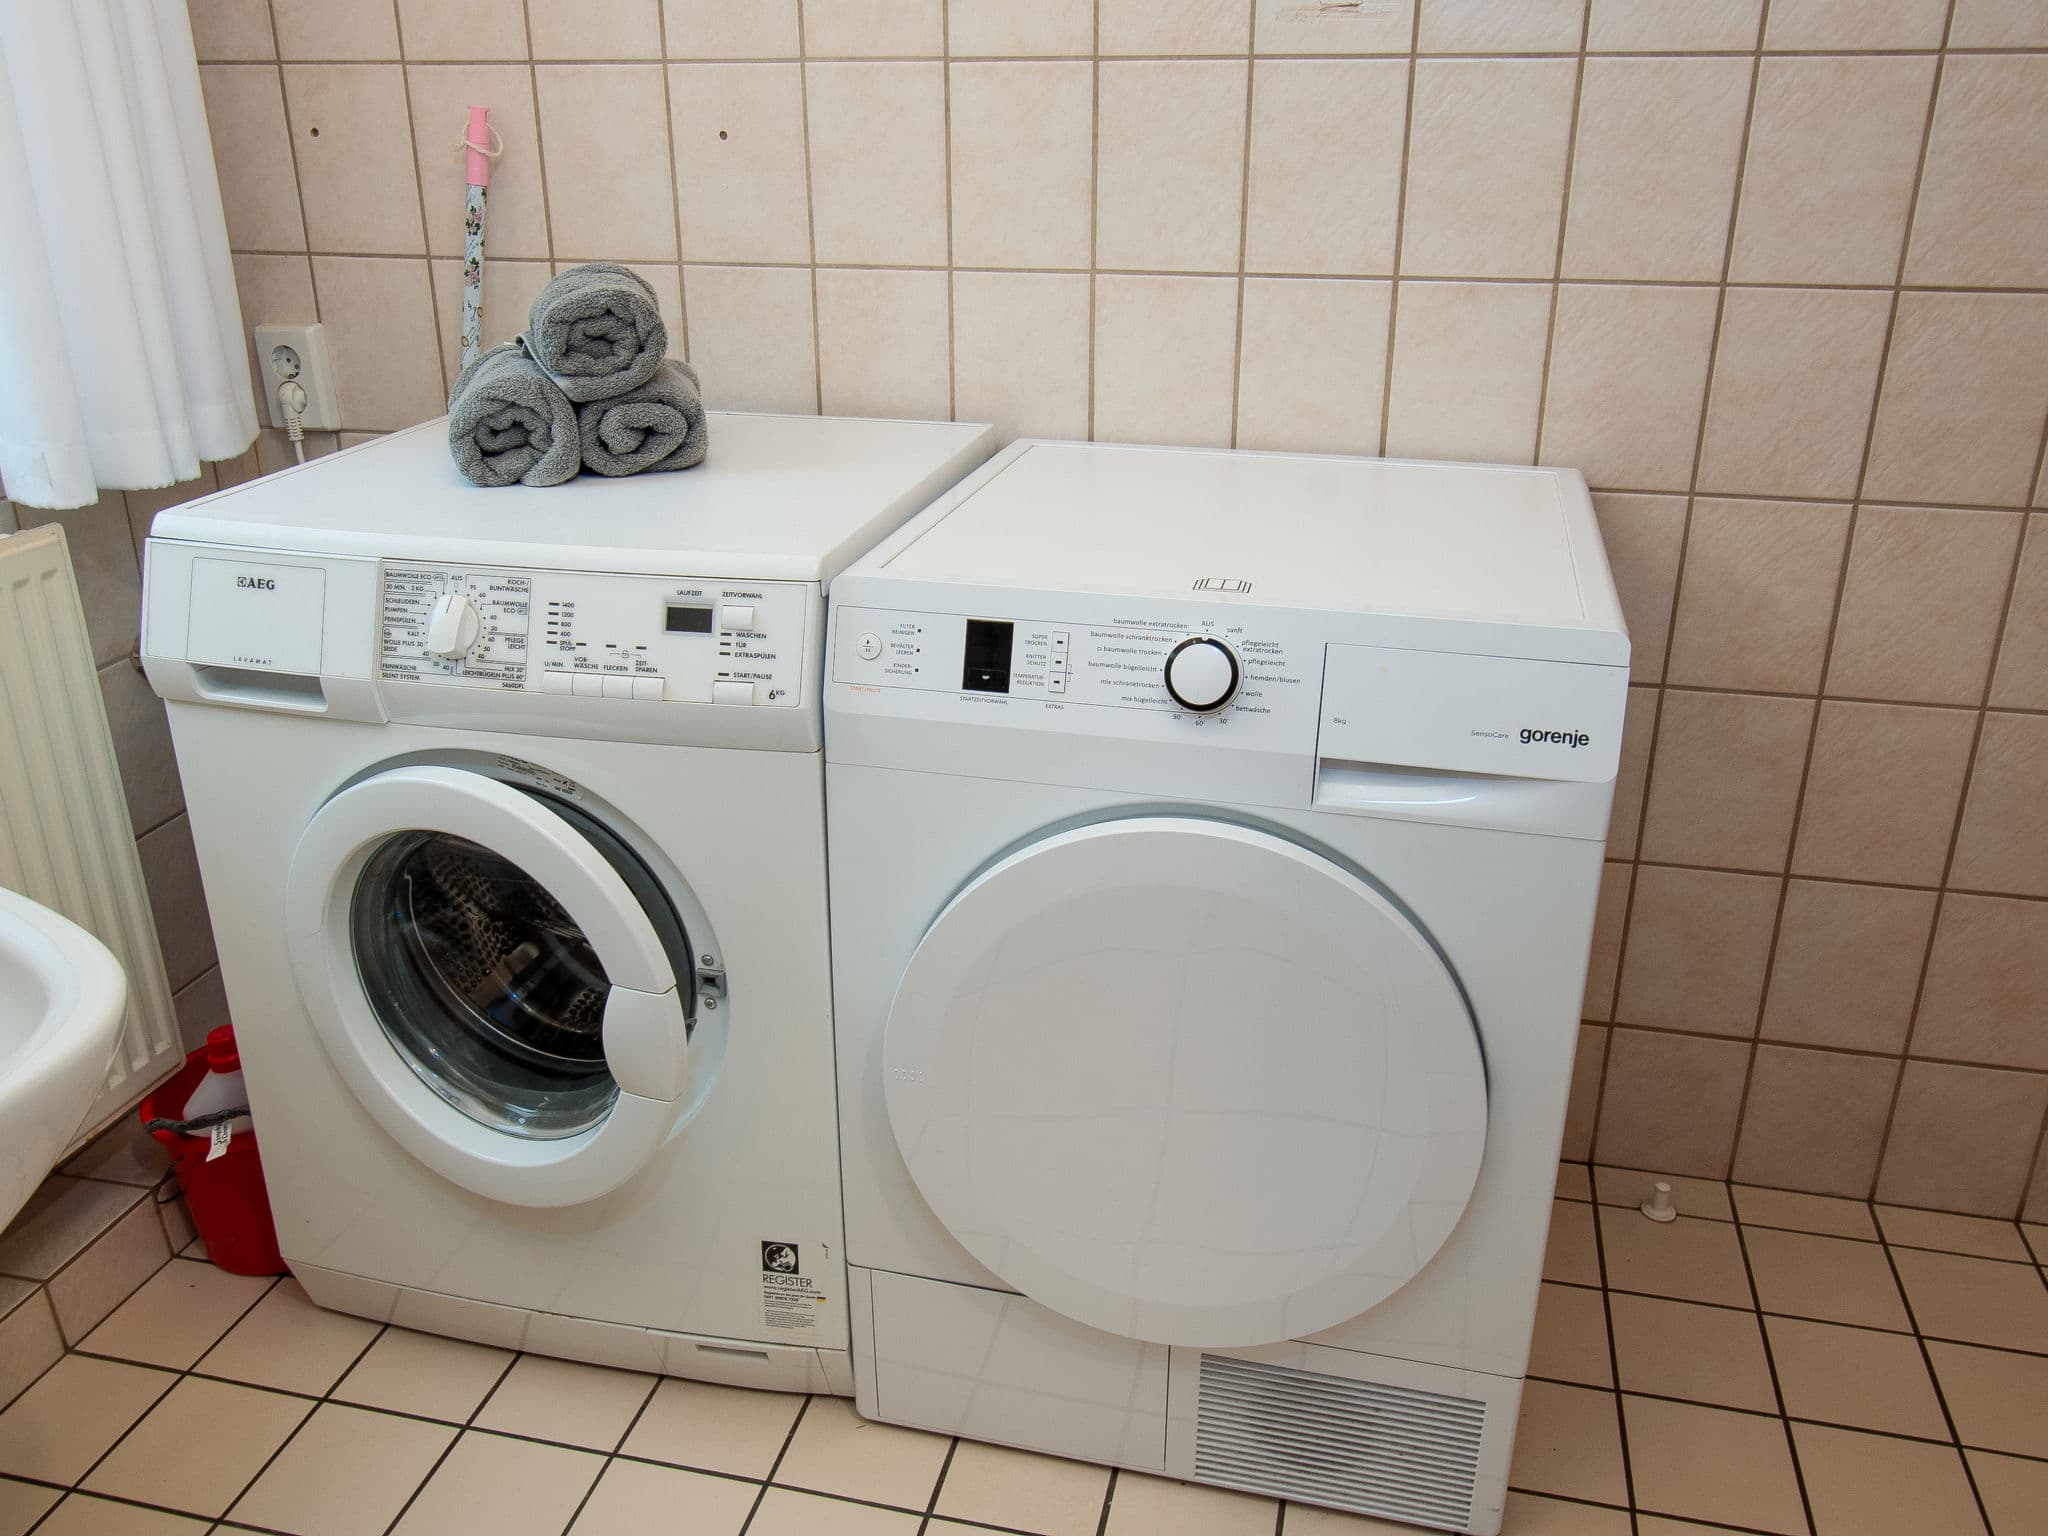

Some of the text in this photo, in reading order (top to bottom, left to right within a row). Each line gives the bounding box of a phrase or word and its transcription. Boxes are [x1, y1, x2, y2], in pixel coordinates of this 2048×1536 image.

[385, 571, 419, 580] BAUMWOLLE
[246, 577, 276, 591] AEG
[676, 589, 703, 597] LAUFZEIT
[722, 591, 763, 599] ZEITVORWAHL
[385, 597, 420, 605] SCHLEUDERN
[492, 599, 528, 608] BAUMWOLLE
[384, 606, 408, 614] PUMPEN
[1113, 617, 1188, 629] baumwolle extratrocken
[1201, 620, 1215, 628] AUS
[1090, 630, 1173, 643] baumwolle schranktrocken
[735, 641, 747, 649] TÜR
[1024, 639, 1048, 647] TROCKEN
[1241, 639, 1279, 649] pflegeleicht
[1103, 645, 1162, 656] baumwolle trocken
[1242, 646, 1284, 655] extratrocken
[734, 651, 777, 660] EXTRASPÜLEN
[233, 655, 272, 666] LAVAMAT
[1247, 658, 1286, 668] pflegeleicht
[603, 664, 629, 672] FLECKEN
[635, 666, 658, 674] SPAREN
[1087, 660, 1158, 673] baumwolle bügelleicht
[382, 672, 399, 680] SILENT
[501, 672, 515, 680] PLUS
[733, 671, 773, 680] START/PAUSE
[1250, 674, 1301, 684] hemden/blusen
[1112, 679, 1160, 689] schranktrocken
[1245, 690, 1263, 698] wolle
[1333, 717, 1347, 725] 8kg
[1471, 726, 1590, 749] SensoCare gorenje
[762, 1274, 812, 1288] REGISTER
